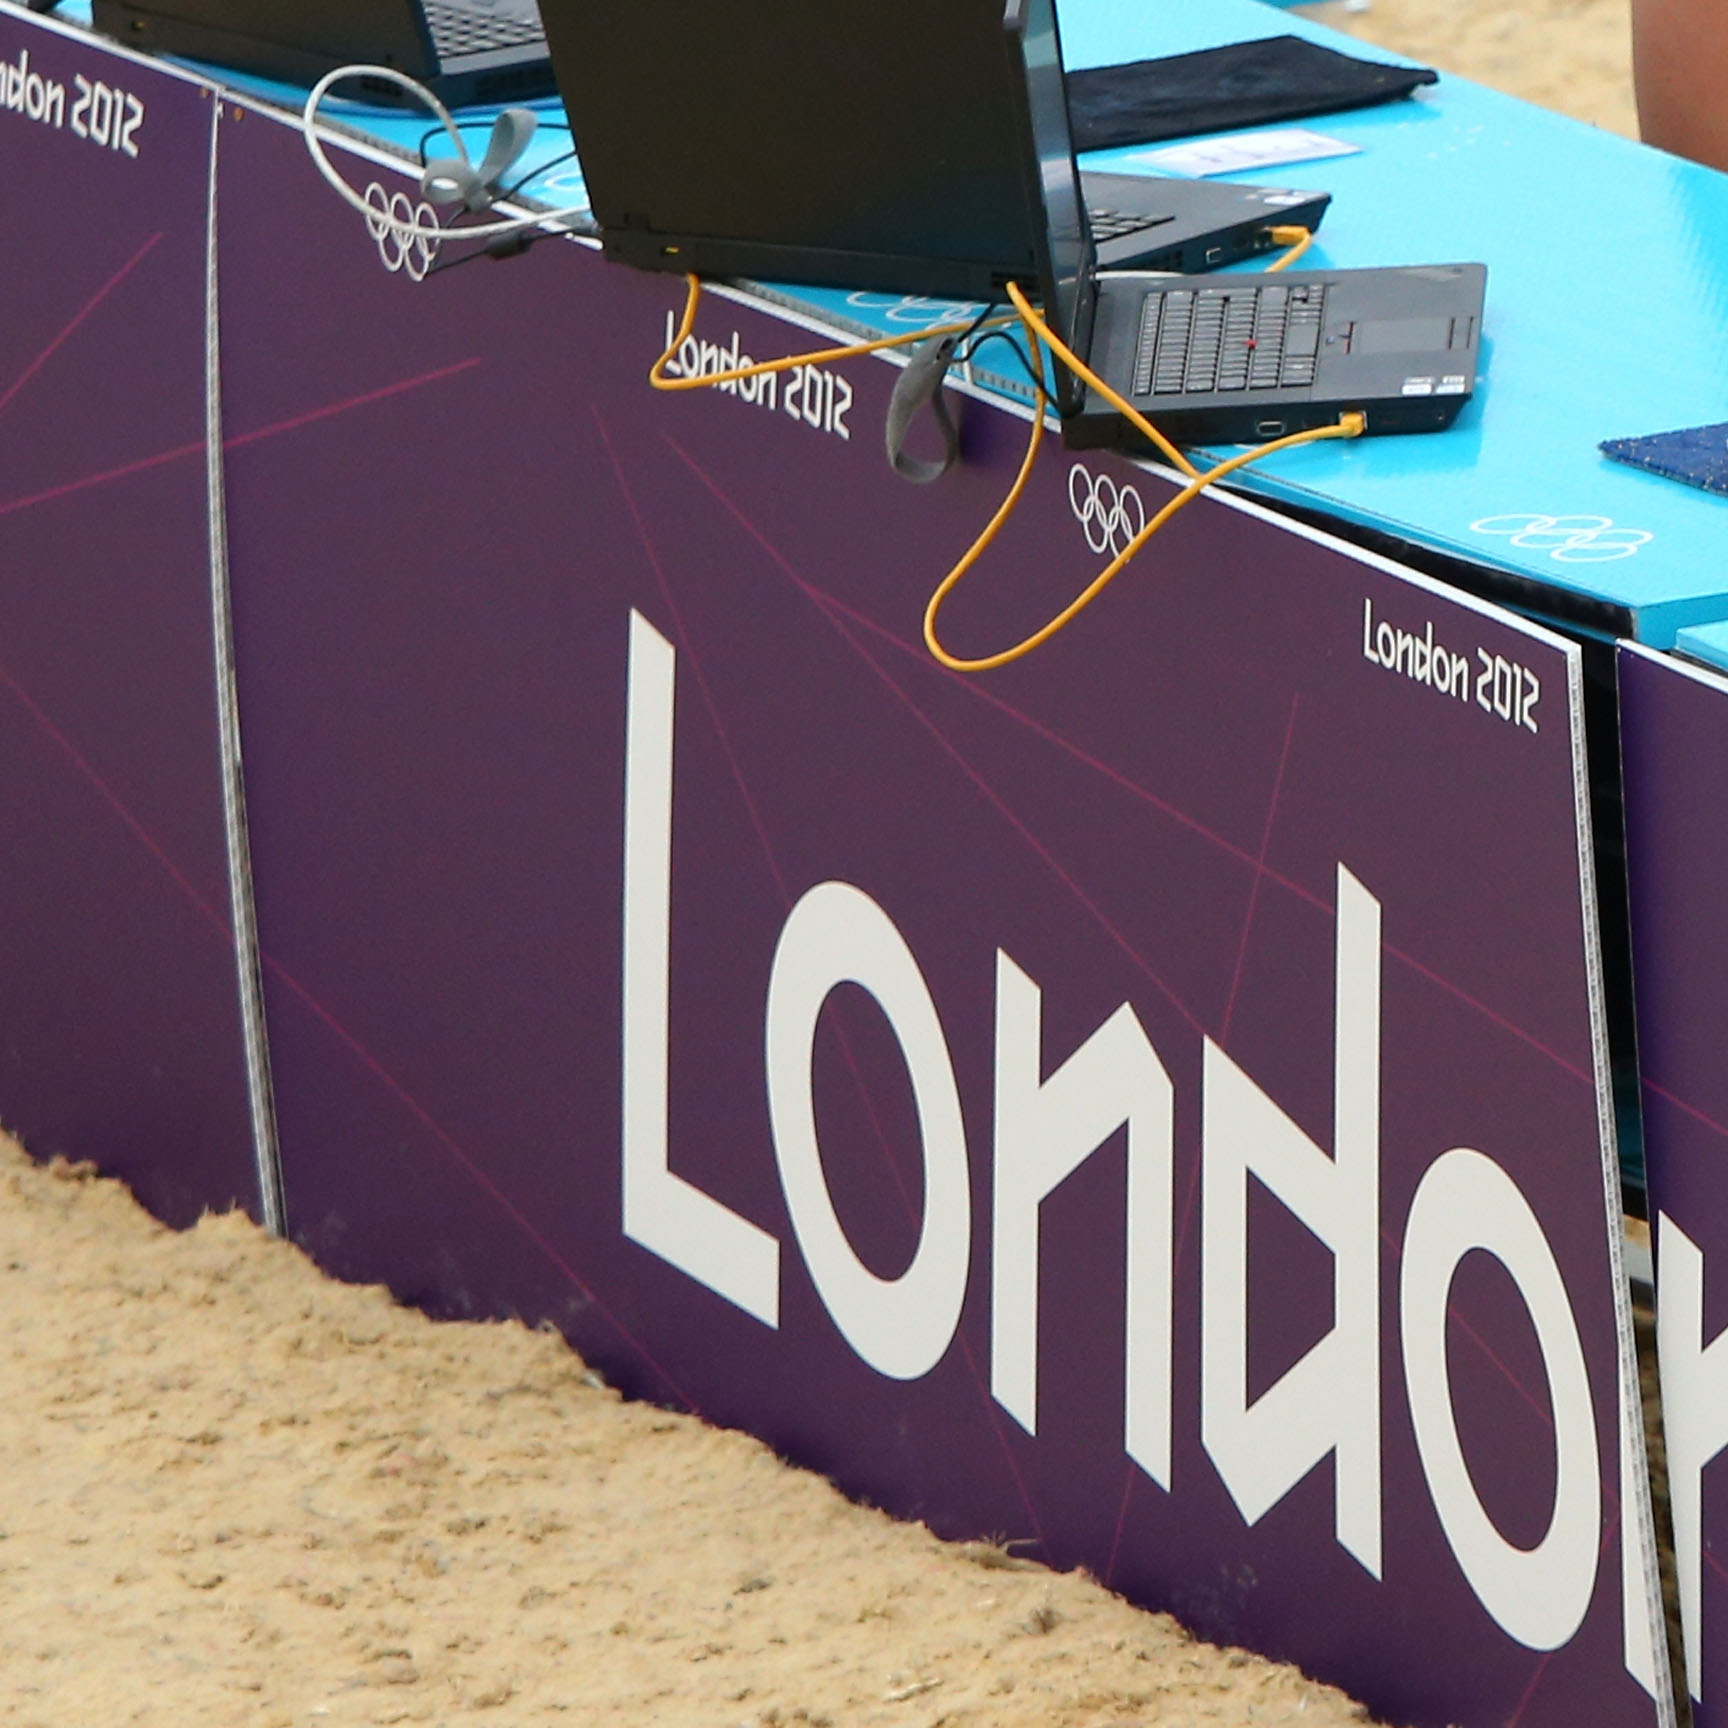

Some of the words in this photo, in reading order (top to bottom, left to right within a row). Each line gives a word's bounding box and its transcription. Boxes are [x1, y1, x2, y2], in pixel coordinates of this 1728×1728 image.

[71, 72, 144, 158] 2012
[665, 310, 777, 411] London
[784, 356, 852, 441] 2012
[1364, 597, 1469, 703] London
[1476, 646, 1540, 734] 2012
